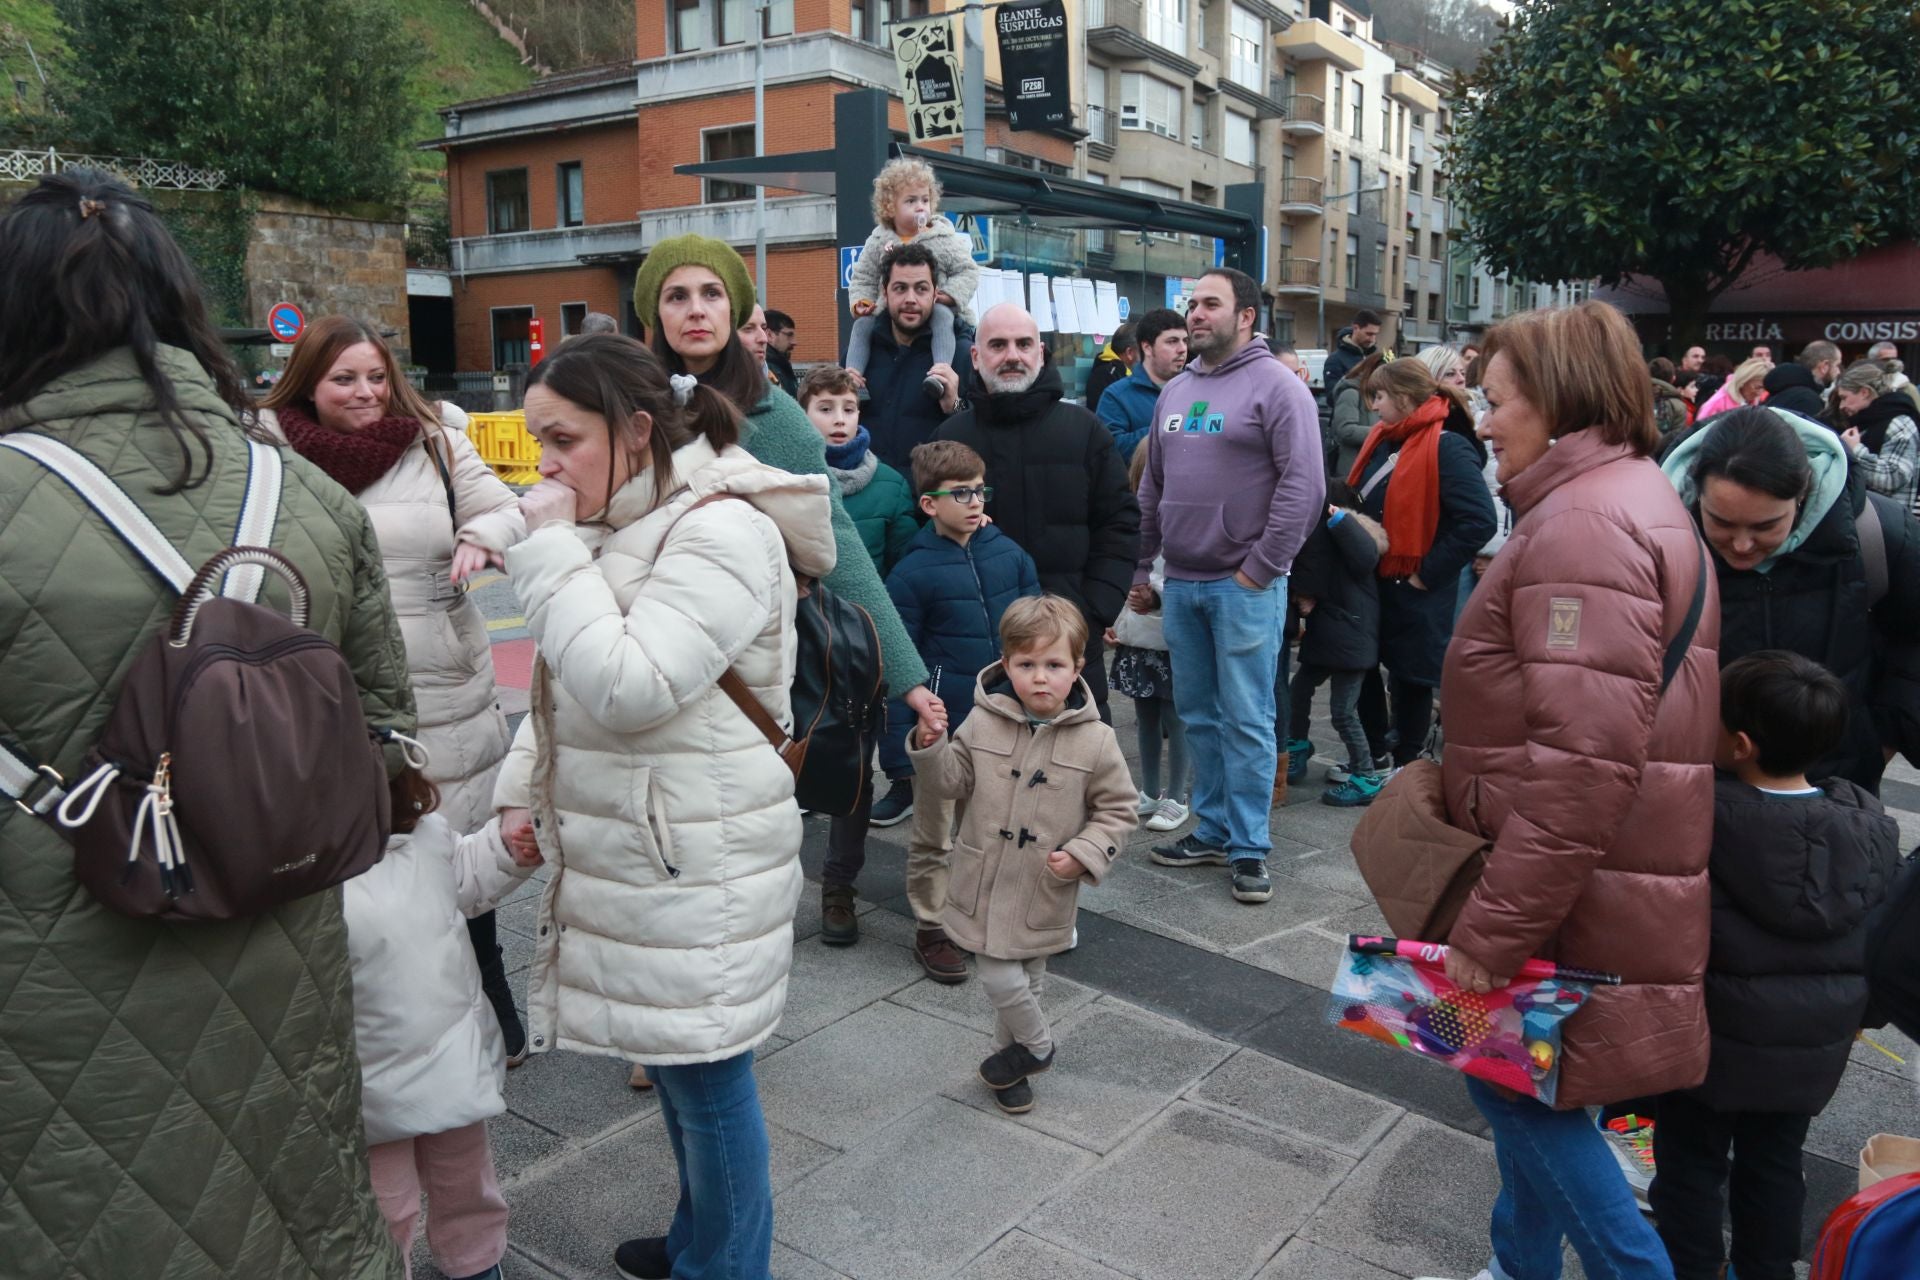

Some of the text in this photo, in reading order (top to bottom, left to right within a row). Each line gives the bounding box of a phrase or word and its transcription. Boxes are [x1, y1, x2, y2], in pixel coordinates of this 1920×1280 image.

[998, 8, 1042, 23] JEANNE
[1000, 15, 1063, 33] SUSPLUGAS
[1024, 81, 1042, 91] PZSB
